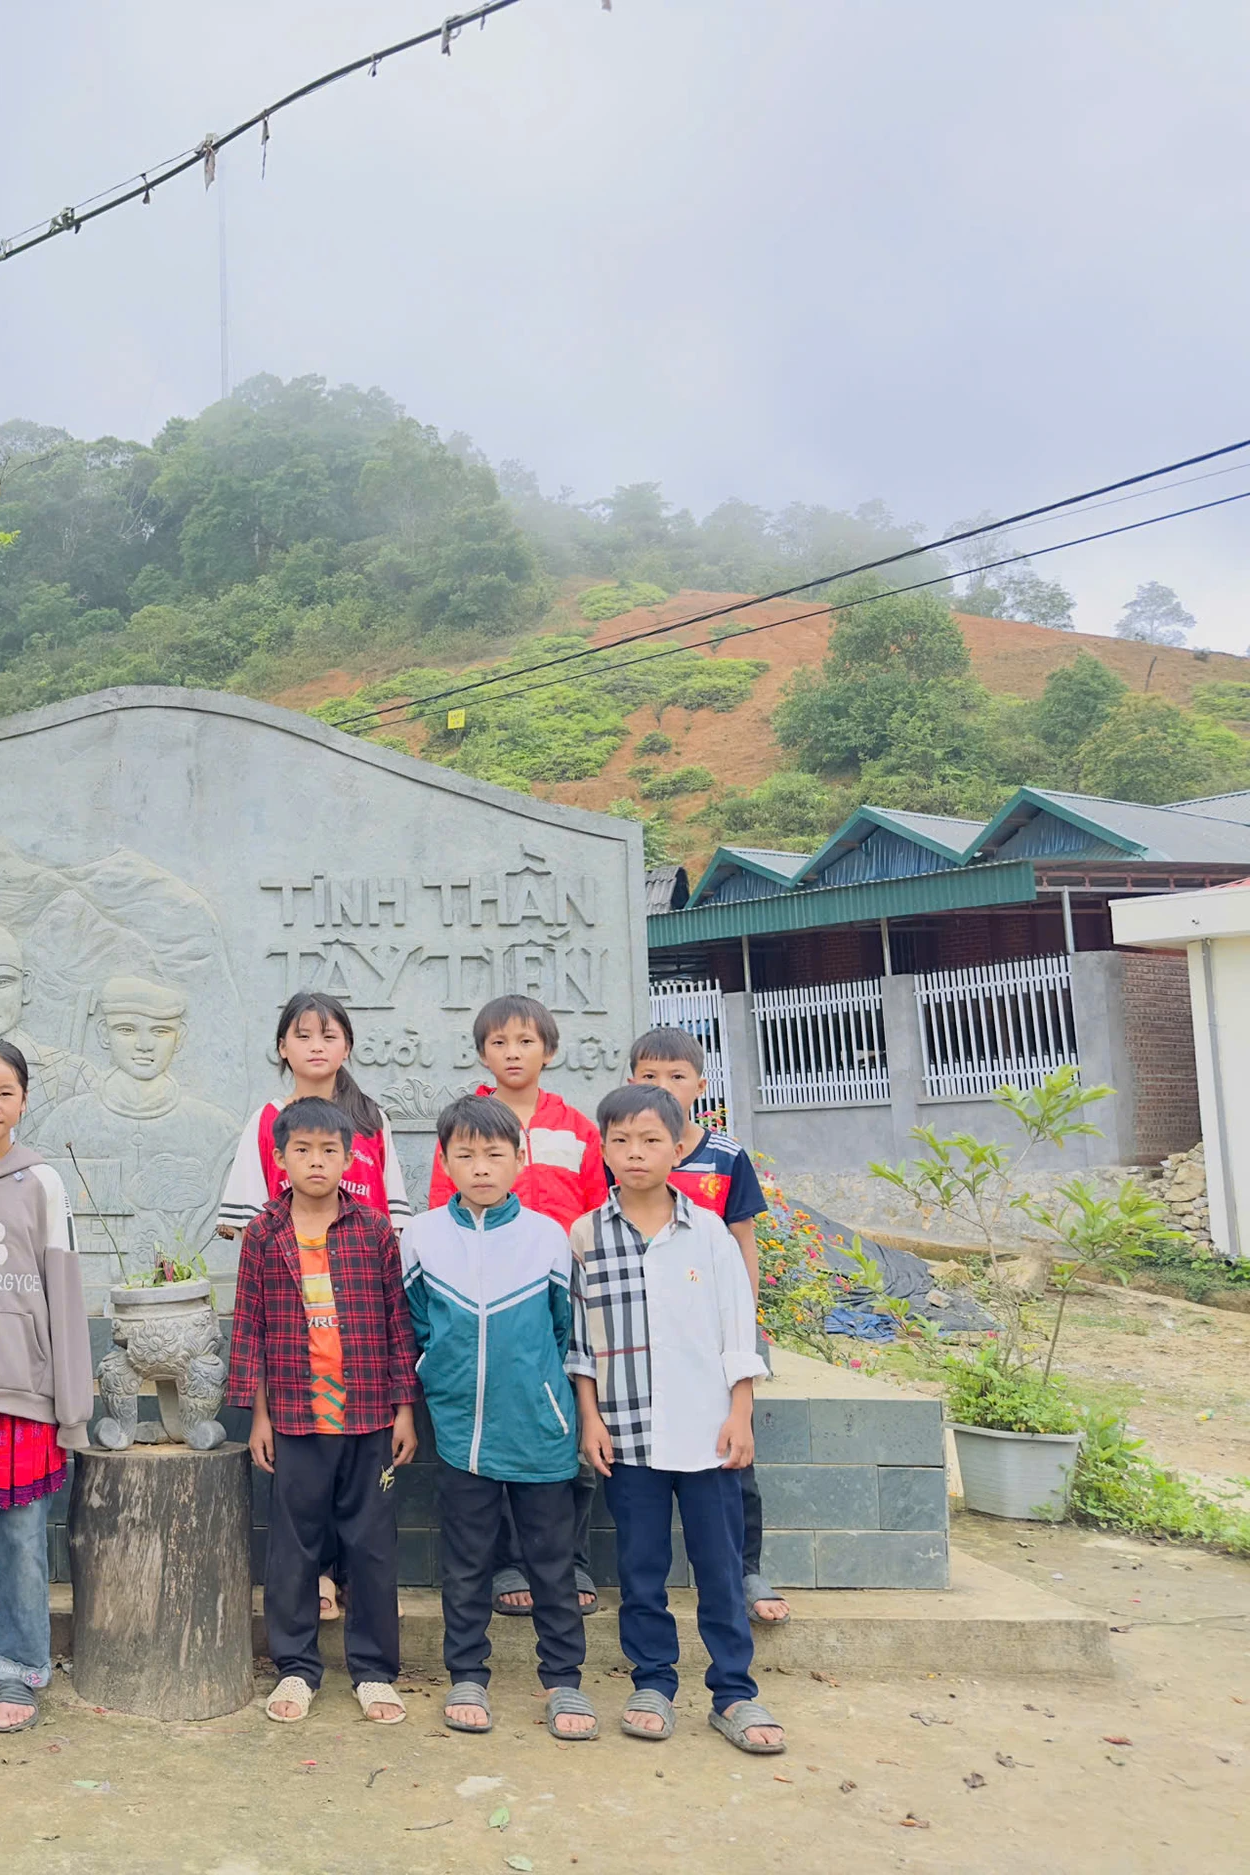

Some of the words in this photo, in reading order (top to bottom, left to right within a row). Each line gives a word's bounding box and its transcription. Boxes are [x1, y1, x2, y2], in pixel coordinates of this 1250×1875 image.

[421, 843, 595, 927] THẦN
[266, 932, 423, 1011] TÂY
[420, 928, 608, 1014] TIẾN
